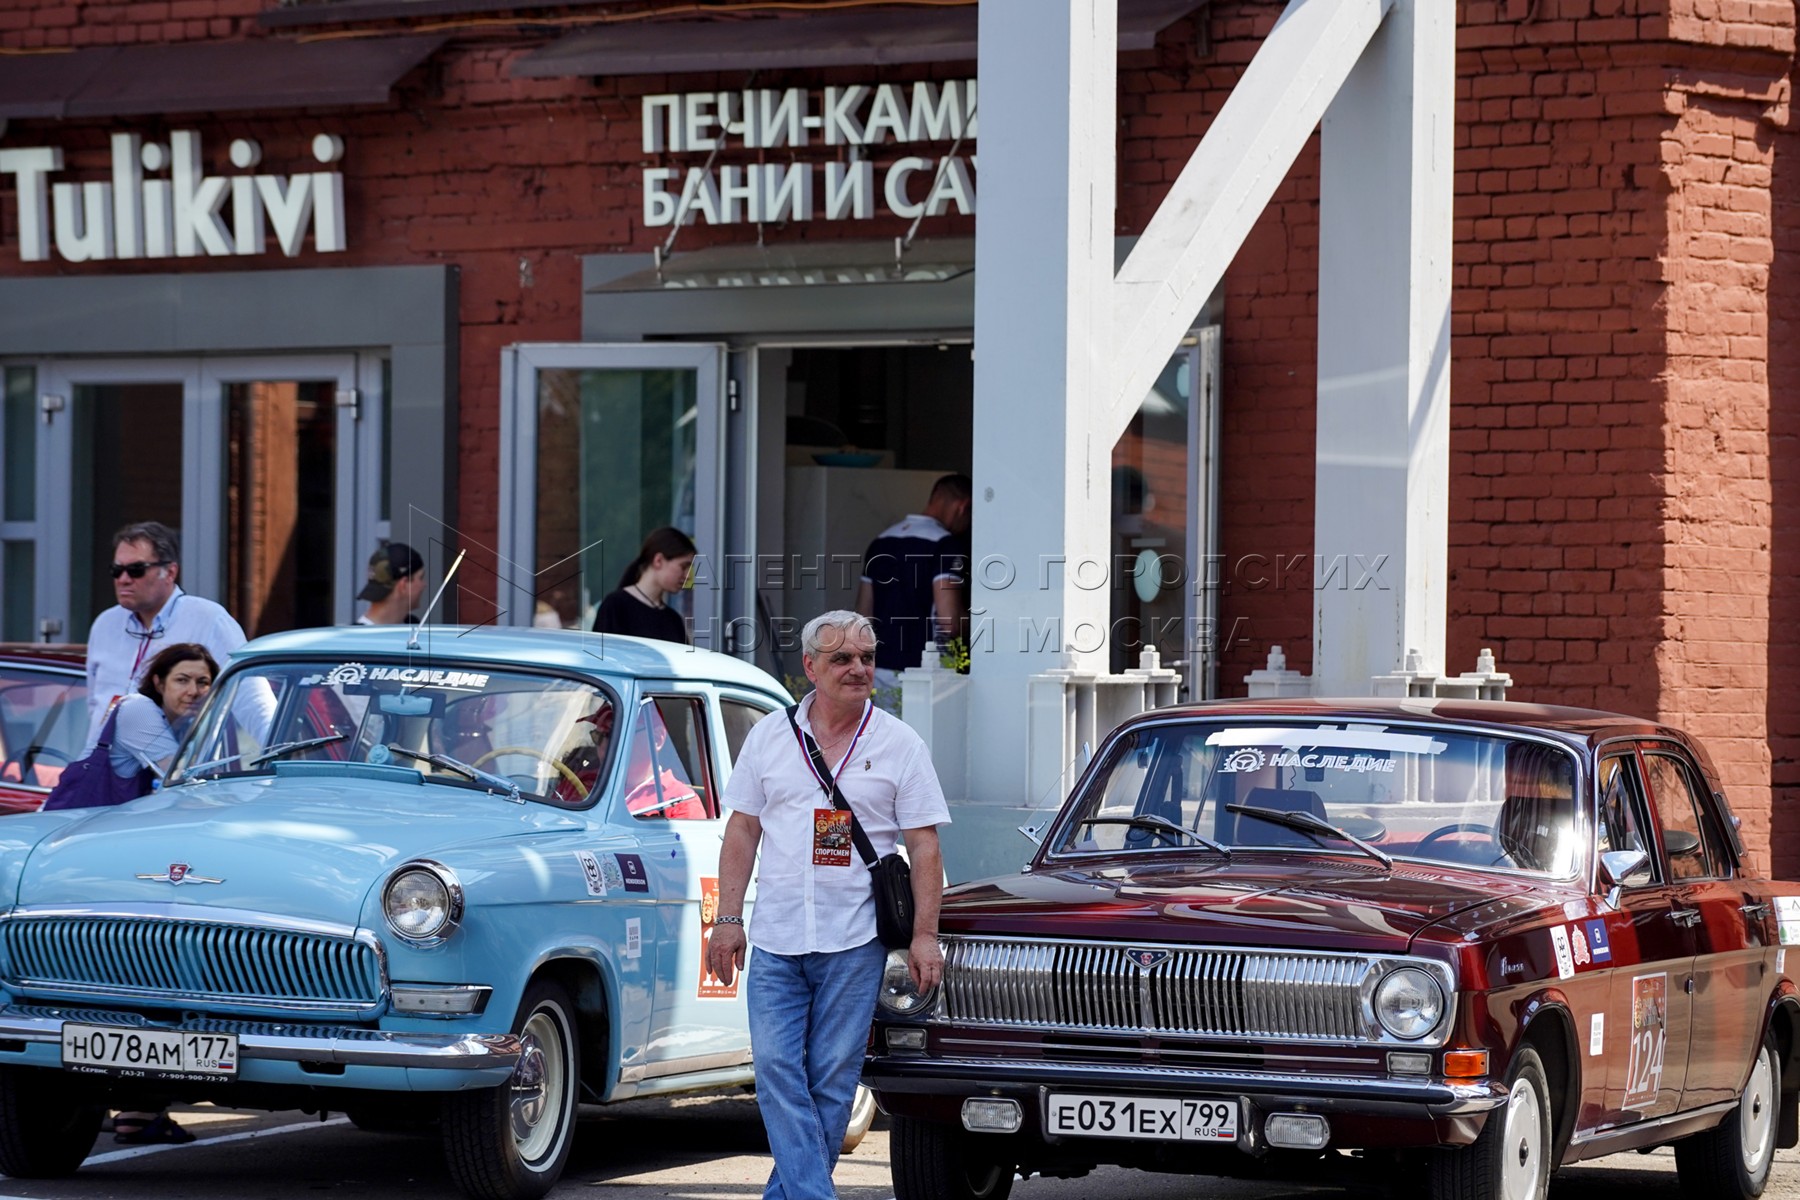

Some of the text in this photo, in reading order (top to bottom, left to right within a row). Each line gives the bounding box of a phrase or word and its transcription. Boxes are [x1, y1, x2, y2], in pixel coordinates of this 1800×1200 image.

[642, 79, 977, 153] ПЕЧИ-КАМ
[0, 130, 346, 262] Tulikivi
[643, 154, 977, 226] БАНИ И СА
[369, 667, 489, 687] НАСЛЕДИЕ
[1269, 754, 1396, 773] НАСЛЕДИЕ
[815, 847, 850, 857] СПОРТСМЕН
[72, 1031, 229, 1066] Н078АМ 177
[196, 1059, 218, 1068] RUS
[1628, 1028, 1663, 1096] 124
[1057, 1099, 1229, 1135] Е031ЕХ 799
[1194, 1127, 1217, 1138] RUS
